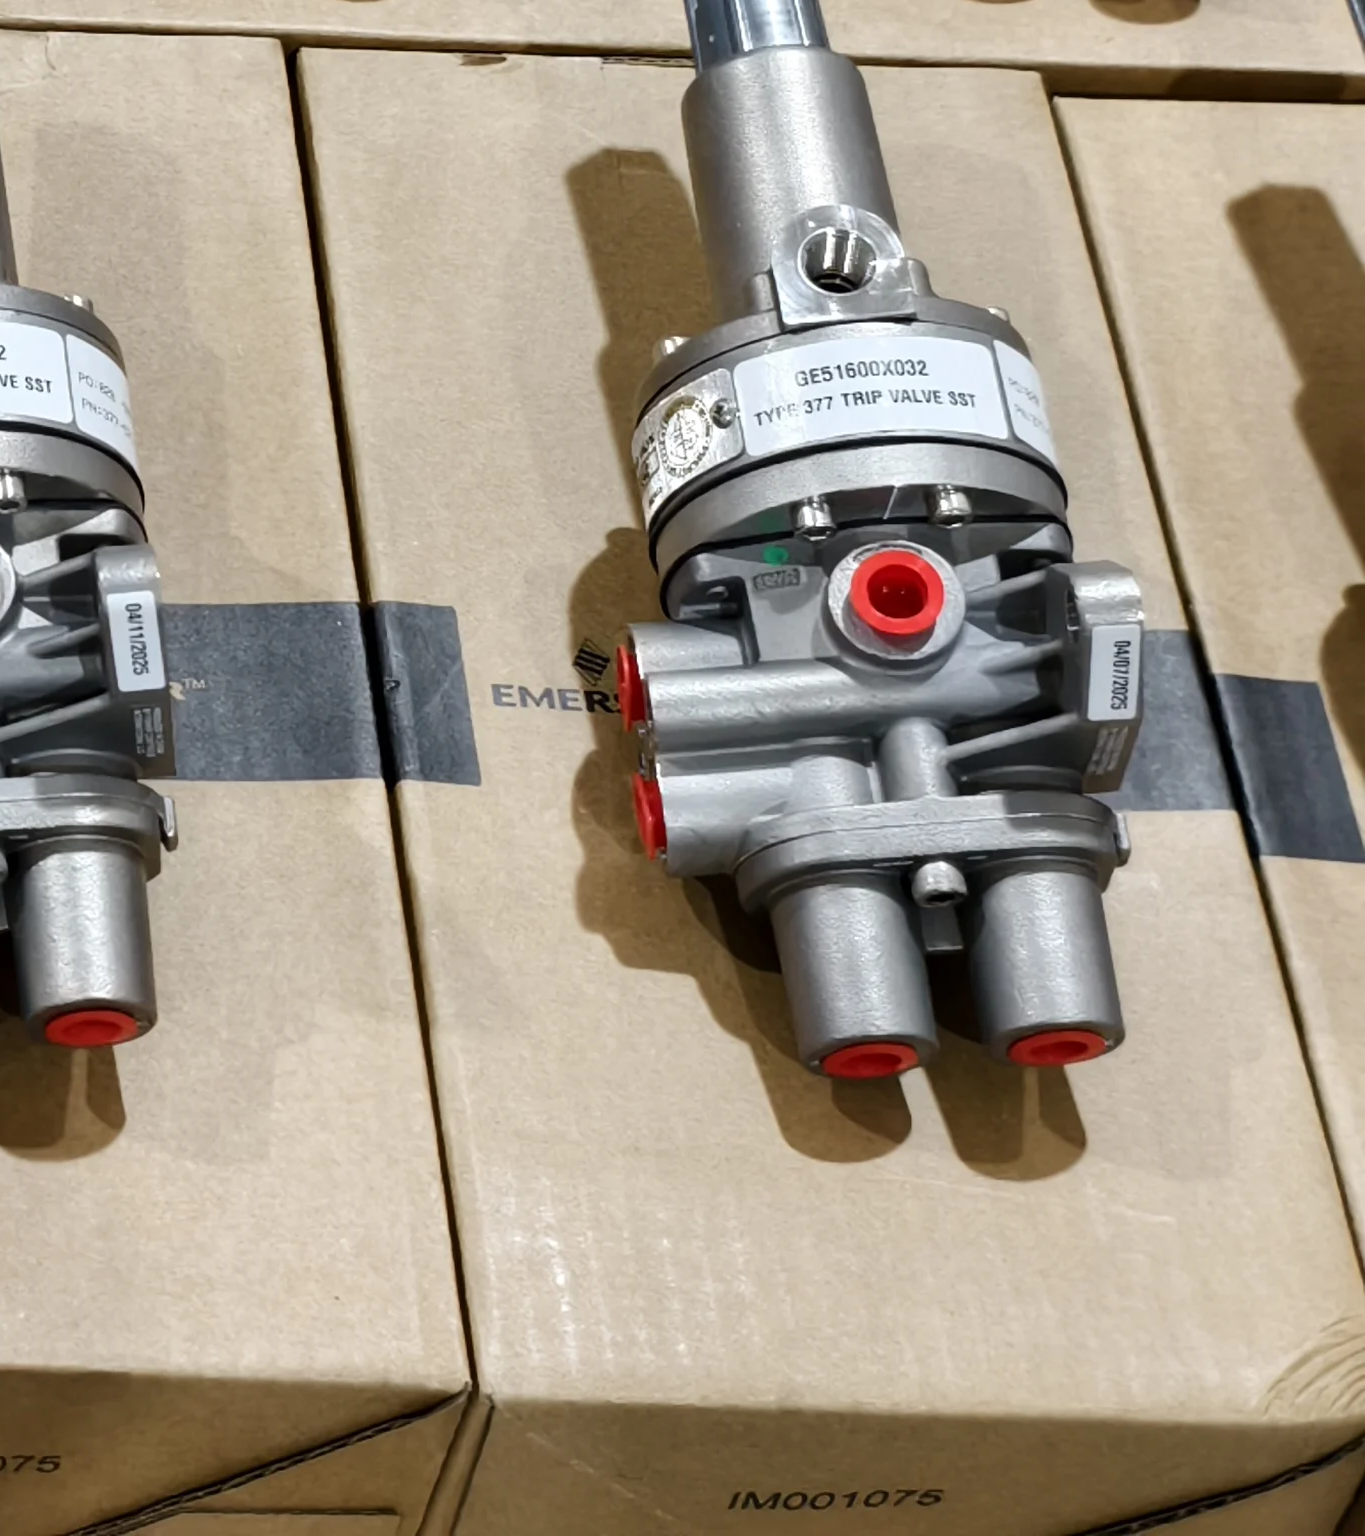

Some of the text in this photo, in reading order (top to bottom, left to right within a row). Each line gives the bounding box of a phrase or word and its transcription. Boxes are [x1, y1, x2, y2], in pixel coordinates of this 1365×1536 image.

[24, 375, 53, 394] SST
[794, 358, 930, 387] GE51600X032
[753, 388, 977, 427] TYPE 377 TRIP VALVE SST
[125, 601, 151, 677] 04/11/2025
[1109, 639, 1132, 711] 04/07/2025
[491, 683, 622, 714] EMER
[728, 1489, 945, 1511] IM001075
